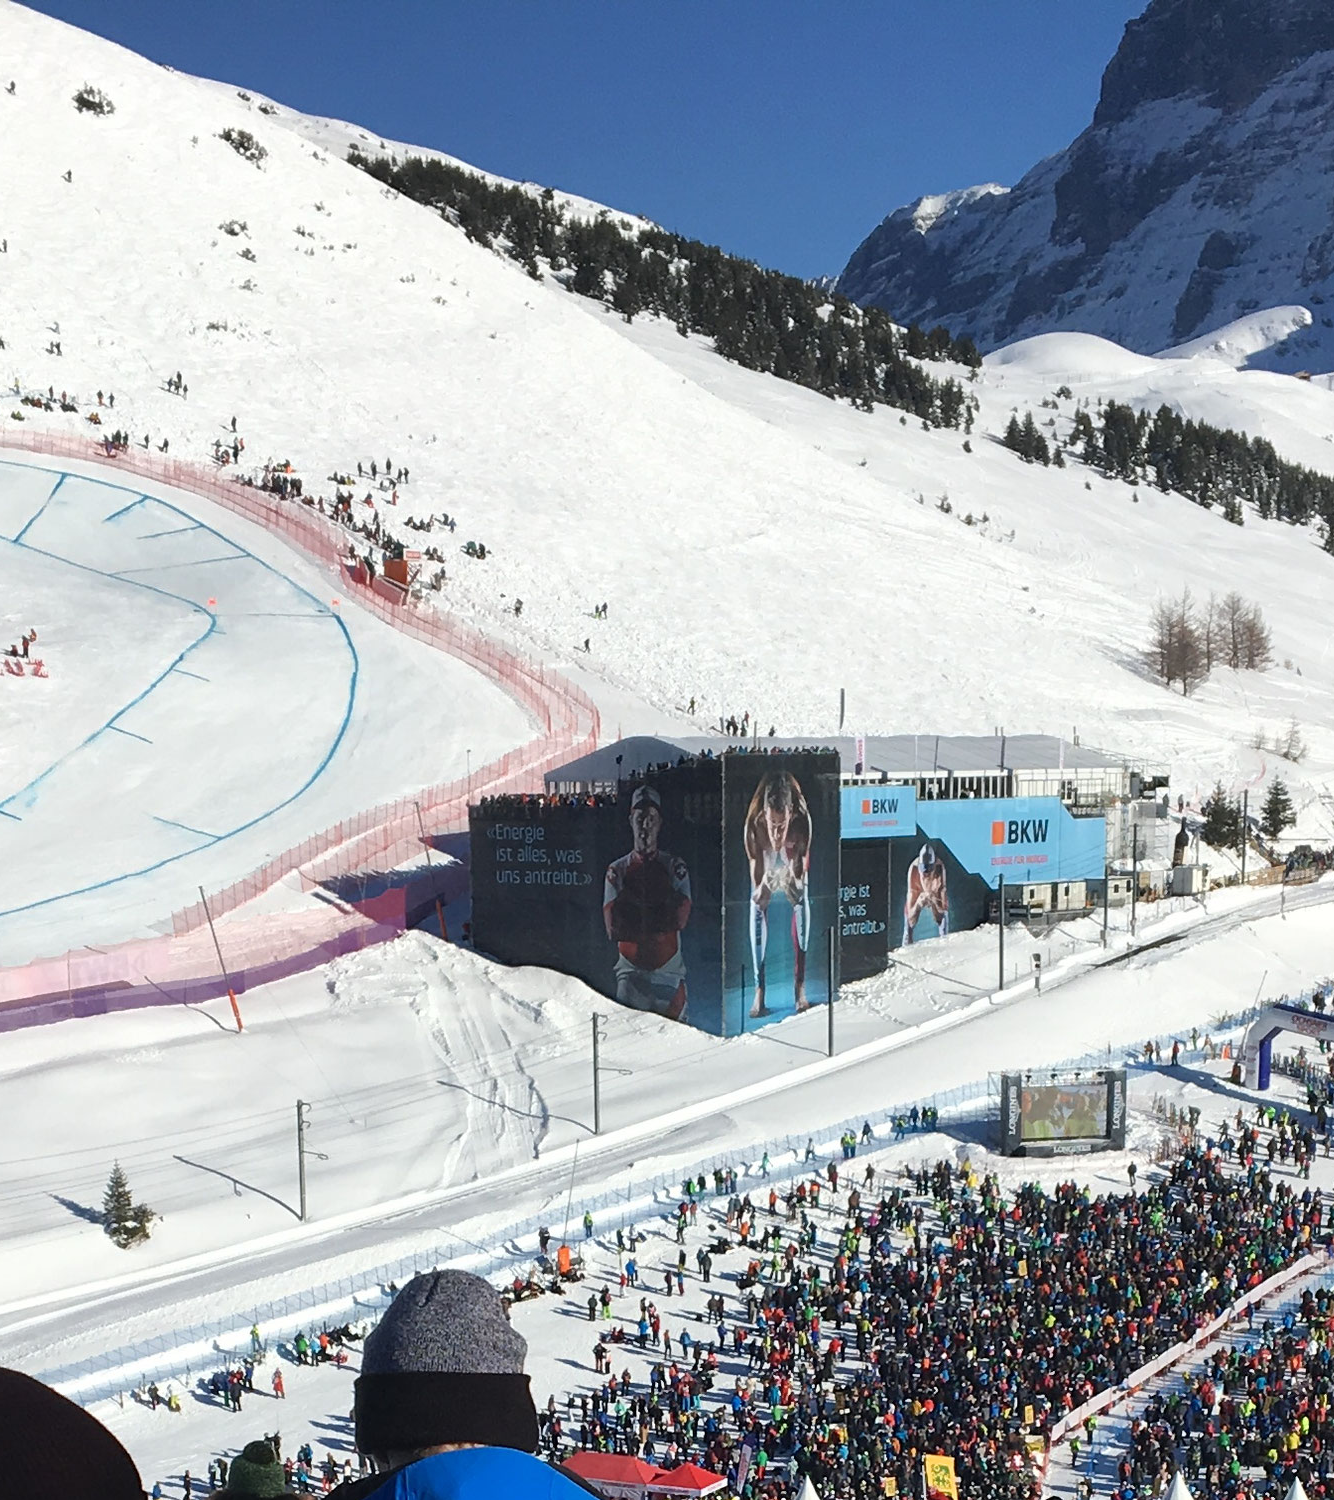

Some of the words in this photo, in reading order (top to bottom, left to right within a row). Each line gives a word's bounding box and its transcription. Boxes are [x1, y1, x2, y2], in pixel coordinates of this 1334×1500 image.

[872, 799, 899, 814] BKW
[487, 823, 545, 844] «Energie
[1008, 819, 1049, 844] BKW
[496, 847, 513, 861] ist
[517, 846, 552, 865] alles,
[555, 849, 583, 863] was
[496, 870, 521, 883] uns
[859, 884, 870, 897] ist
[849, 904, 867, 916] was
[1008, 1086, 1017, 1135] LONGINES
[1112, 1081, 1121, 1129] LONGINES
[1053, 1144, 1091, 1153] LONGINES
